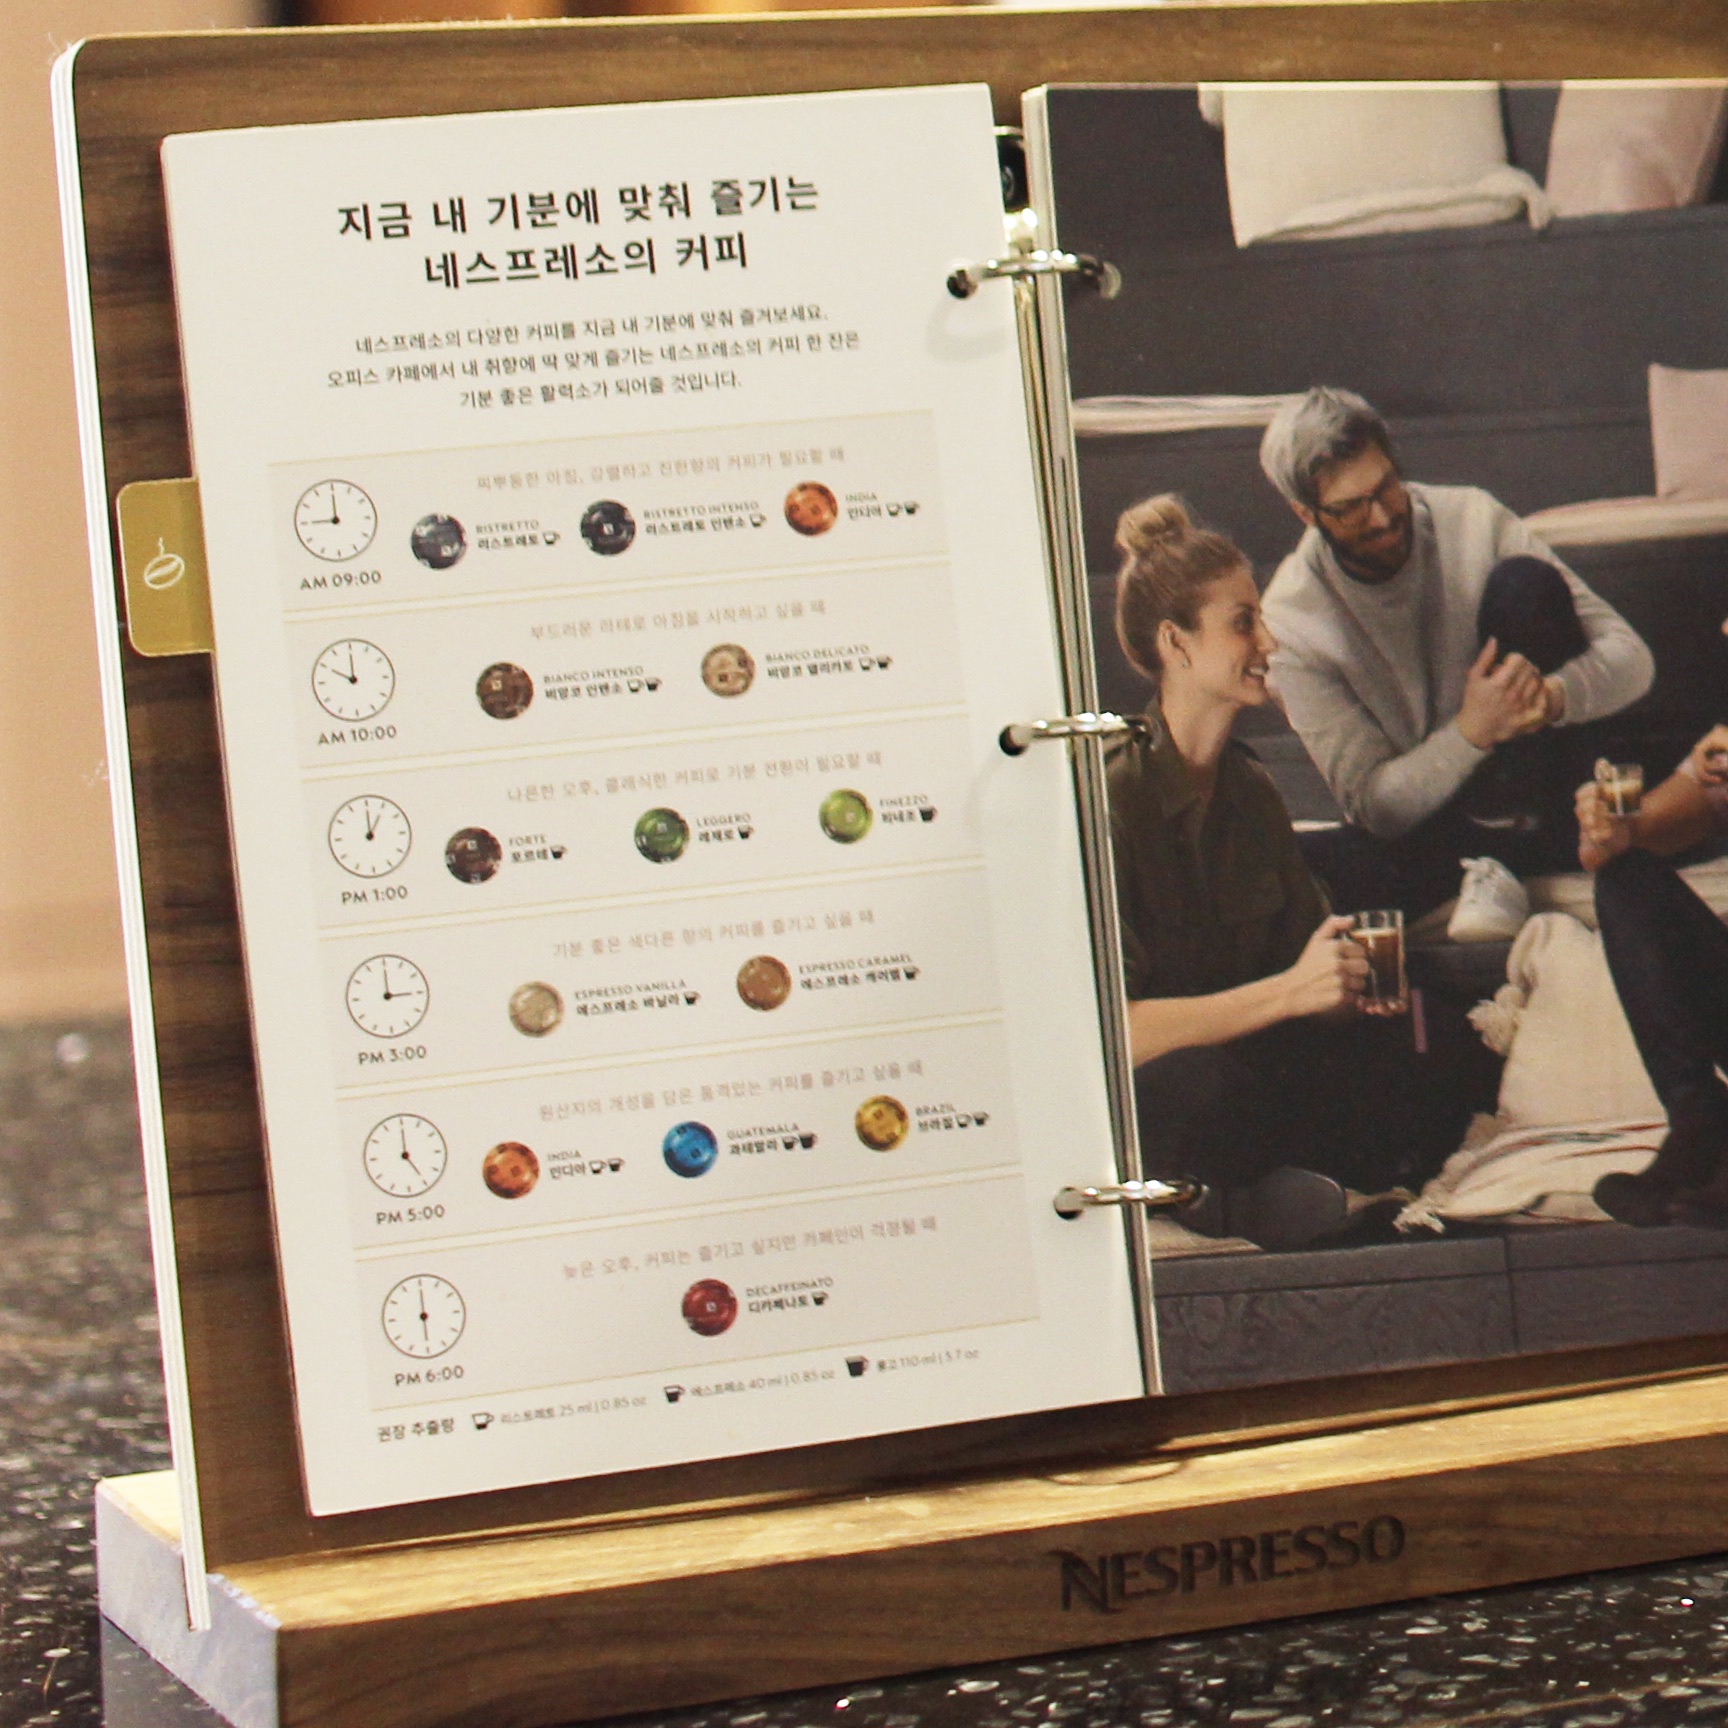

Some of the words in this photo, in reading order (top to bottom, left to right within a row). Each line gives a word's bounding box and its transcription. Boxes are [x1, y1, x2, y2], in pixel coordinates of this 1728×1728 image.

[337, 201, 413, 241] 지금
[432, 196, 468, 234] 내
[487, 187, 600, 231] 기분에
[618, 181, 692, 223] 맞춰
[710, 175, 819, 217] 즐기는
[424, 237, 657, 290] 네스프레소의
[676, 231, 747, 272] 커피
[355, 329, 462, 355] 네스프레소의
[466, 325, 520, 347] 다양한
[527, 321, 577, 342] 커피를
[583, 318, 616, 338] 지금
[621, 316, 639, 335] 내
[646, 312, 696, 333] 기분에
[700, 309, 734, 329] 맞춰
[739, 304, 828, 327] 즐겨보세요.
[327, 367, 379, 388] 오피스
[387, 361, 456, 384] 카페에서
[461, 358, 479, 378] 내
[485, 354, 537, 376] 취향에
[541, 353, 559, 371] 딱
[564, 350, 599, 370] 맞게
[604, 346, 654, 368] 즐기는
[659, 338, 762, 362] 네스프레소의
[769, 334, 801, 354] 커피
[806, 333, 822, 353] 한
[828, 330, 860, 351] 잔은
[461, 389, 493, 409] 기분
[499, 386, 533, 407] 좋은
[539, 379, 609, 404] 활력소가
[614, 375, 665, 397] 되어줄
[672, 370, 743, 393] 것입니다.
[727, 451, 773, 471] 커피가
[300, 575, 327, 590] AM
[333, 570, 381, 587] 09:00
[766, 649, 810, 663] BIANCO
[812, 644, 870, 658] DELICATO
[318, 730, 345, 746] AM
[352, 725, 397, 742] 10:00
[674, 766, 721, 785] 커피로
[341, 889, 368, 905] PM
[374, 885, 408, 903] 1:00
[358, 1050, 383, 1065] PM
[390, 1045, 427, 1062] 3:00
[727, 1122, 800, 1140] GUATEMALA
[376, 1210, 402, 1224] PM
[408, 1204, 446, 1221] 5:00
[395, 1371, 421, 1386] PM
[426, 1365, 464, 1383] 6:00
[378, 1425, 405, 1443] 권장
[1047, 1515, 1406, 1614] NESPRESSO
